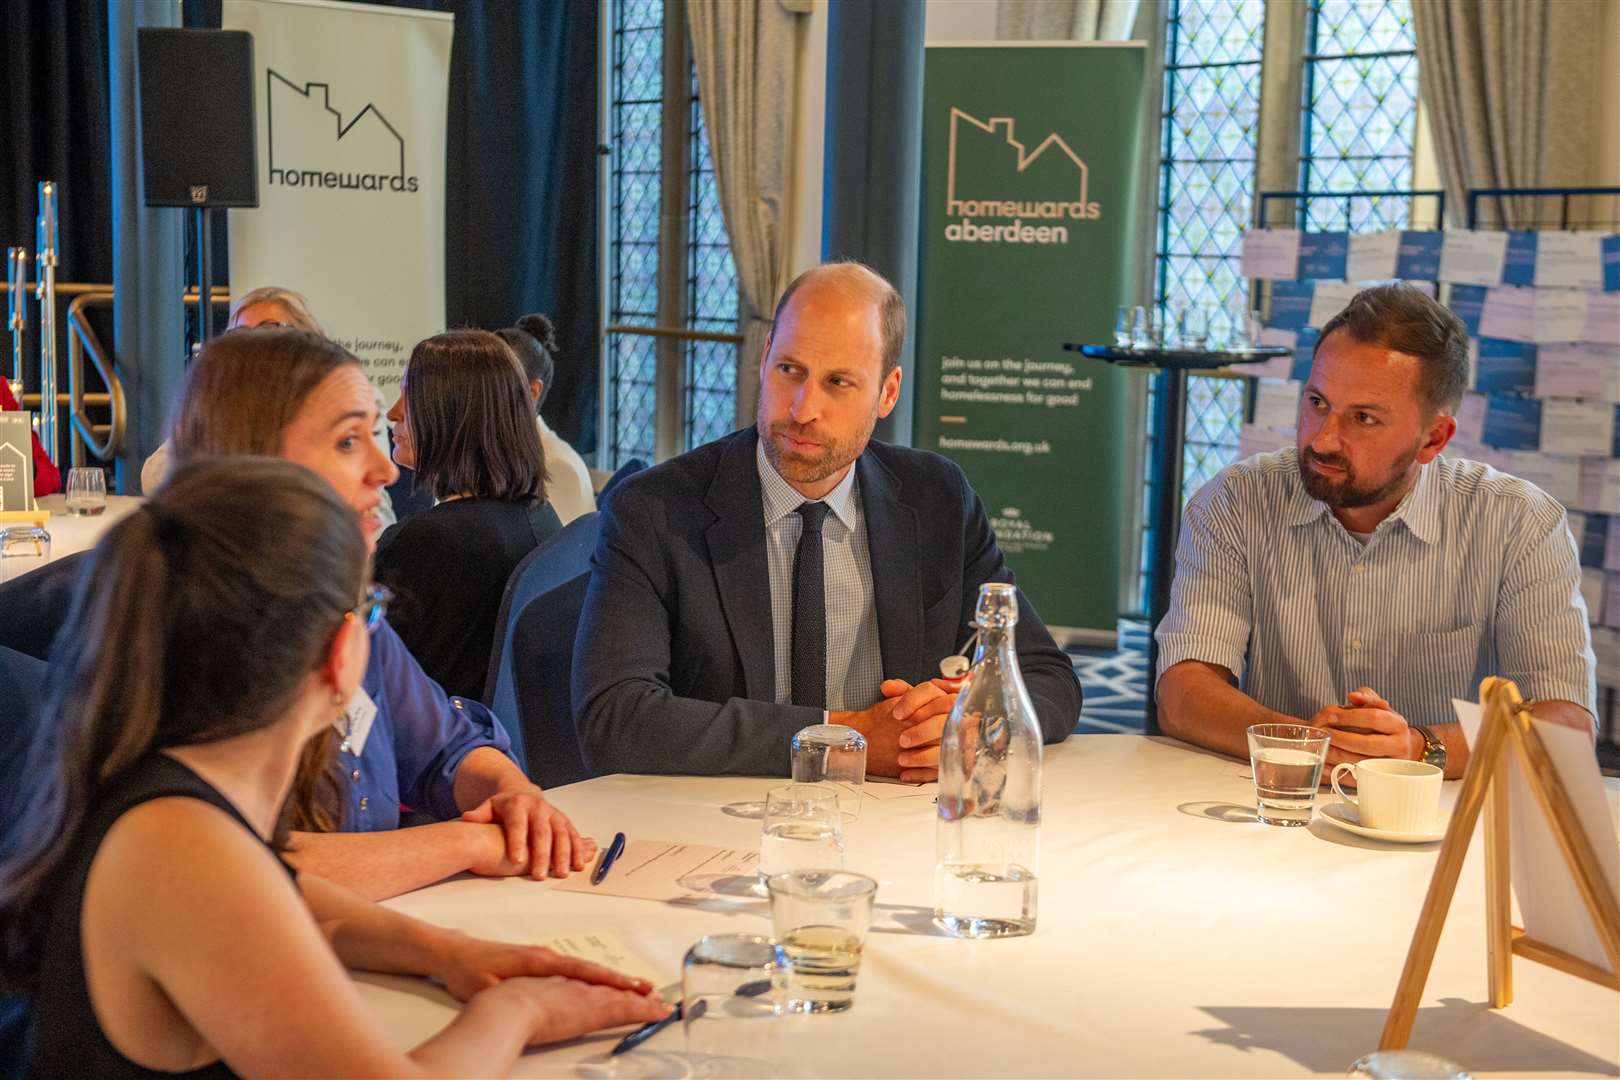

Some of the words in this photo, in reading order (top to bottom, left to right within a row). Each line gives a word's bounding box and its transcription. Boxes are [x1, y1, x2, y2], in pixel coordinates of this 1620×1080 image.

[268, 168, 419, 193] homewards
[946, 199, 1101, 219] homewards
[944, 218, 1068, 243] aberdeen
[373, 358, 395, 368] can
[942, 356, 965, 370] join
[967, 359, 981, 369] us
[984, 360, 999, 370] on
[1002, 358, 1022, 371] the
[377, 374, 401, 387] goo
[941, 373, 966, 385] and
[968, 374, 1020, 389] together
[1023, 378, 1040, 388] we
[1042, 378, 1065, 389] can
[1068, 377, 1092, 390] end
[940, 388, 1024, 403] homelessness
[1026, 391, 1043, 403] for
[1046, 393, 1079, 407] good
[939, 436, 1049, 455] homewards.org.uk
